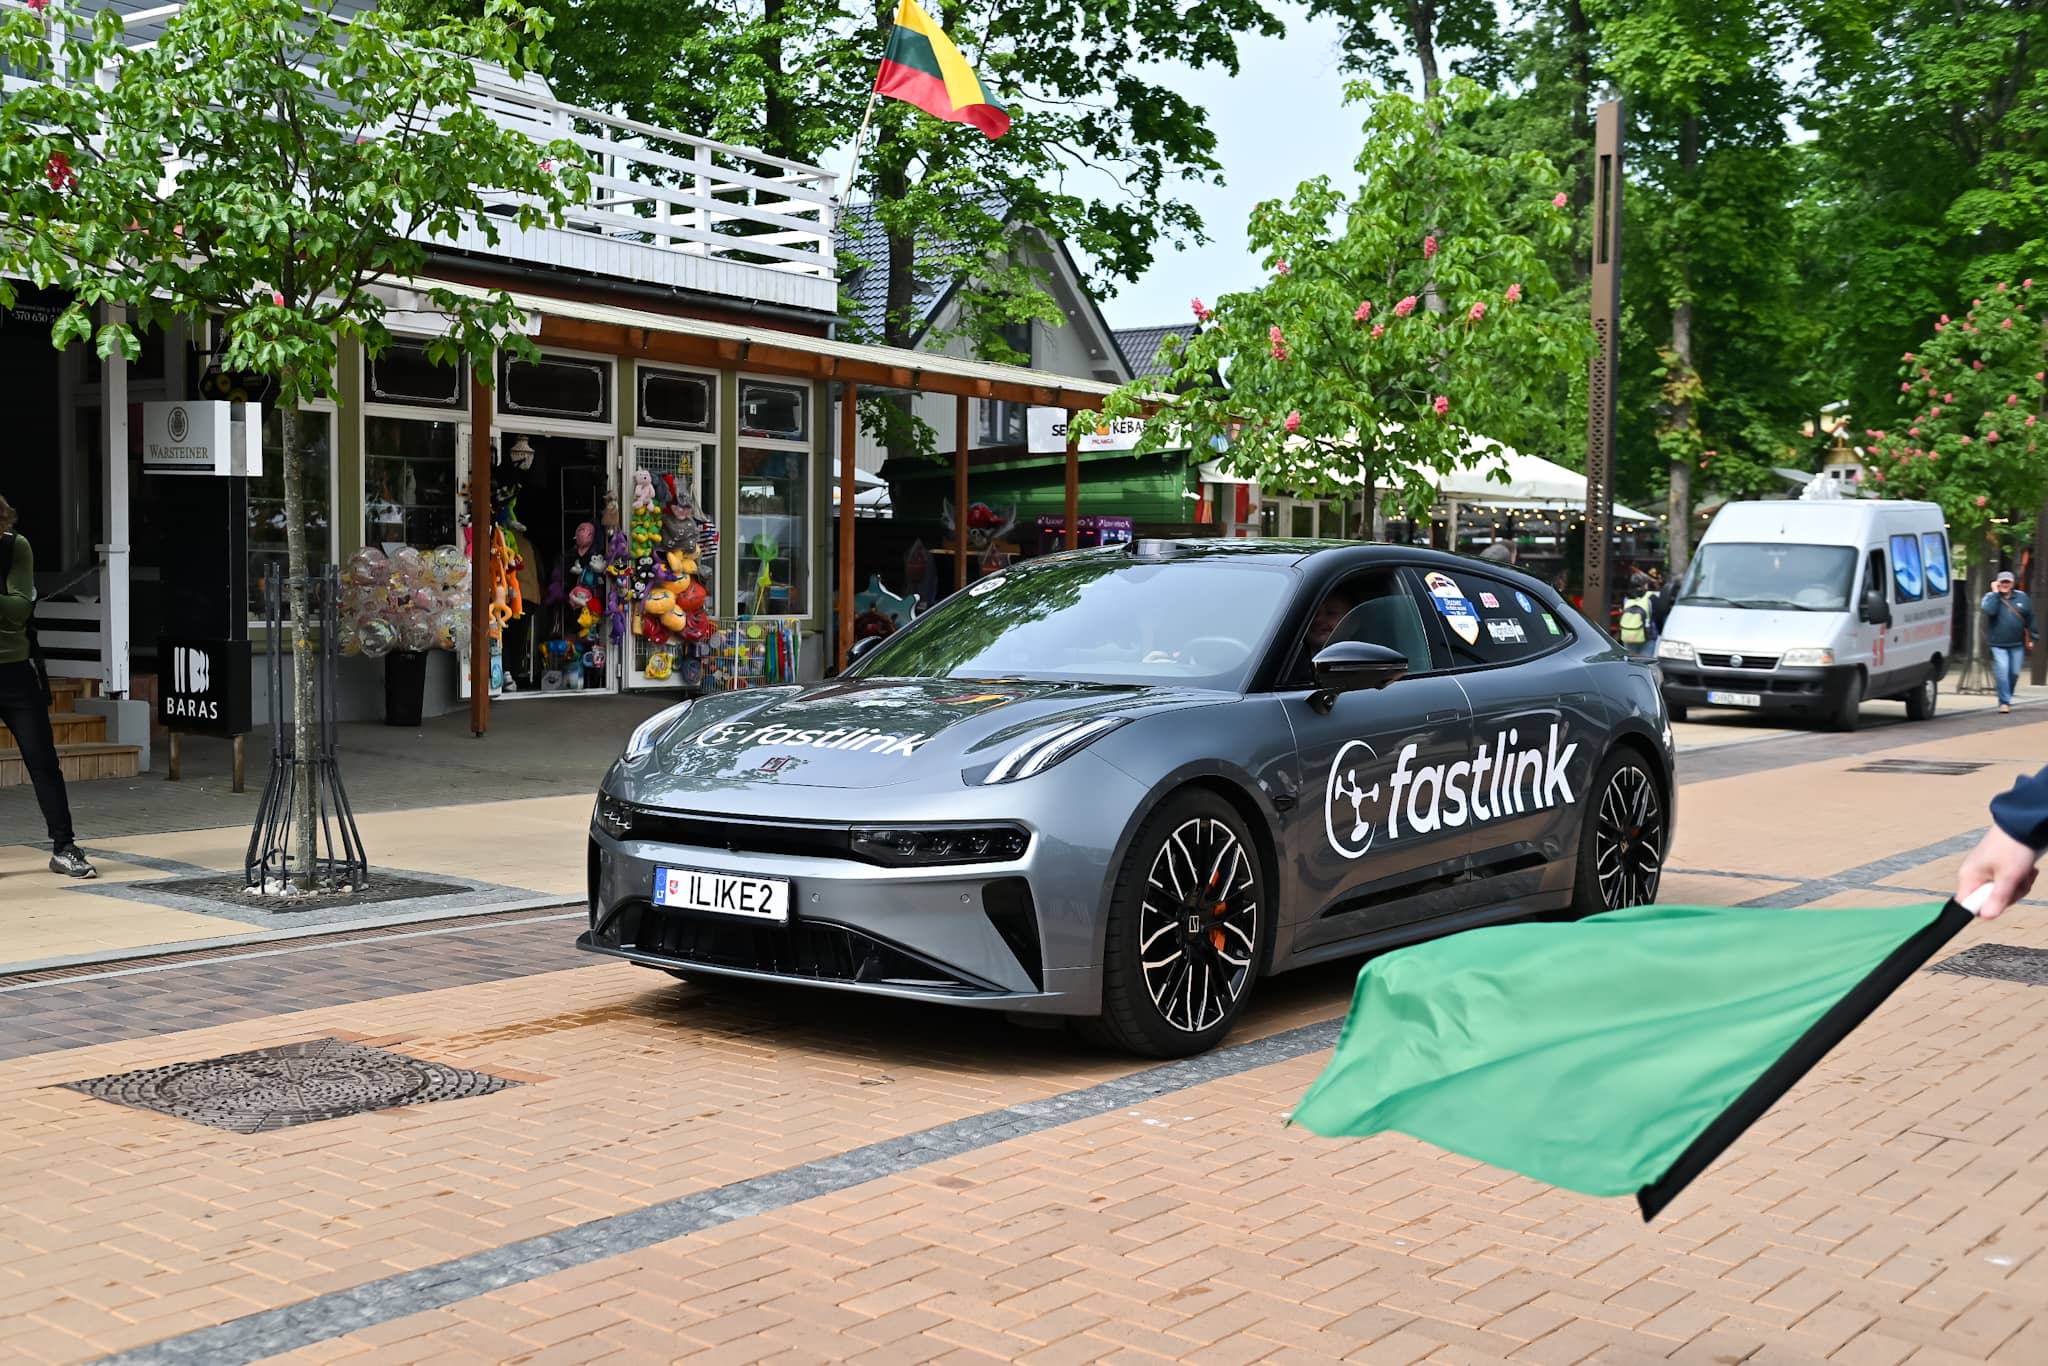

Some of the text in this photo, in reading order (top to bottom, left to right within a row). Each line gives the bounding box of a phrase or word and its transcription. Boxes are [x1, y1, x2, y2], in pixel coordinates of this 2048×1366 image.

[149, 444, 209, 460] WARSTEINER
[166, 697, 218, 720] BARAS
[738, 723, 936, 757] fastlink
[1387, 723, 1579, 840] fastlink
[689, 875, 774, 914] ILIKE2
